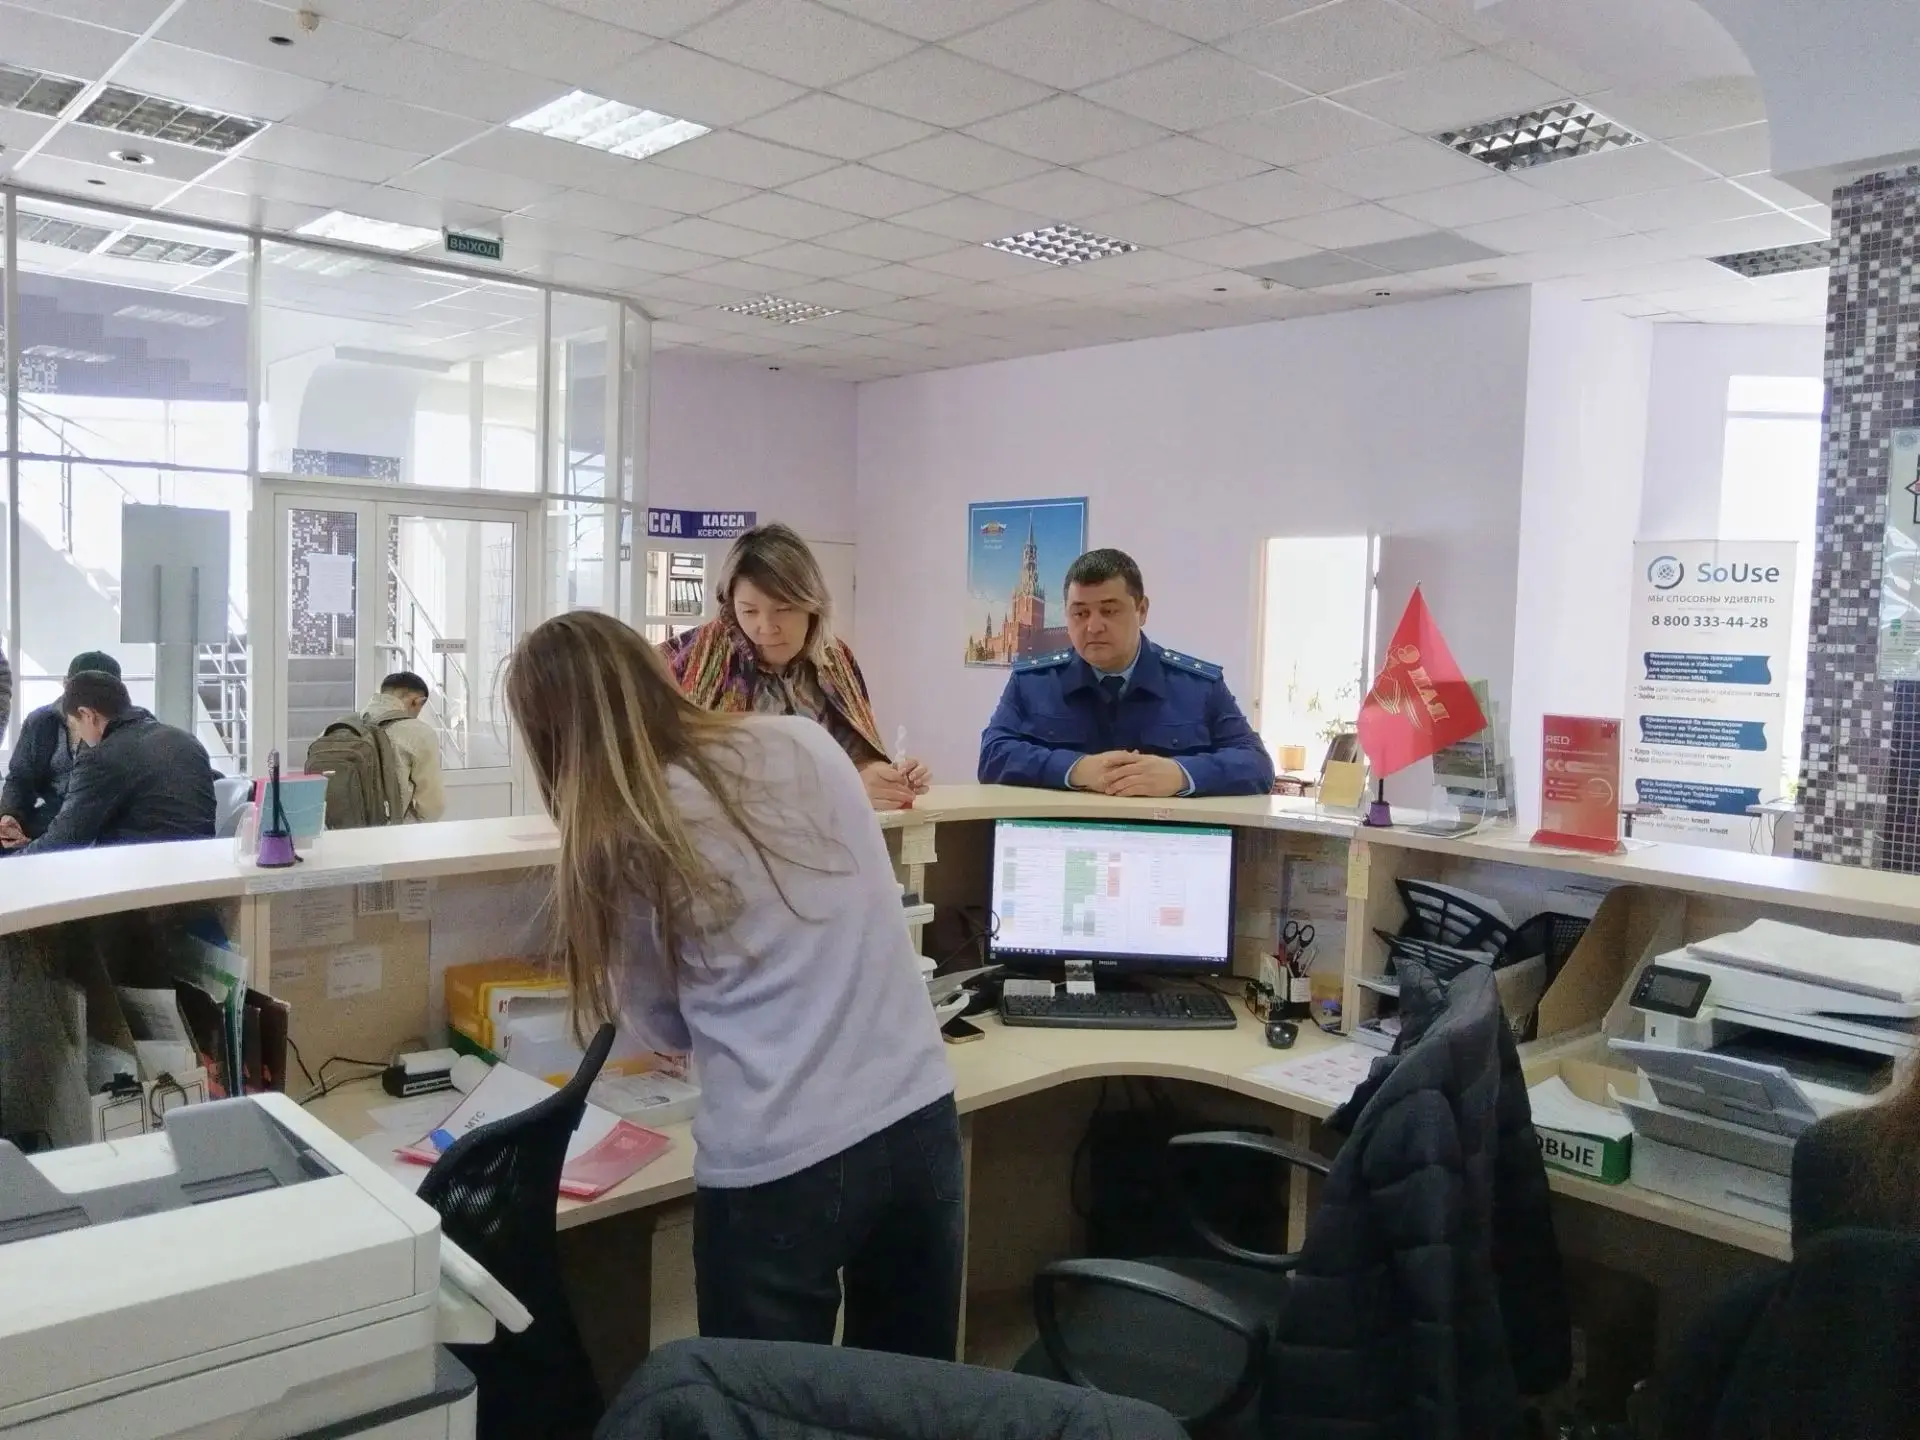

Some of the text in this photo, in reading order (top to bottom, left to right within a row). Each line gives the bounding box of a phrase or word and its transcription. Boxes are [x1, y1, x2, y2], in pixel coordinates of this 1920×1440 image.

[450, 237, 497, 256] ВЫХОД
[648, 511, 682, 534] ССА
[702, 514, 745, 527] КАССА
[698, 529, 744, 537] КСЕРОКОПИ
[1697, 562, 1780, 582] SoUse
[1666, 595, 1721, 603] СПОСОБНЫ
[1724, 596, 1776, 604] УДИВЛЯТЬ
[1651, 615, 1768, 628] 8 800 333-44-28
[1545, 735, 1570, 745] RED
[464, 1111, 485, 1129] МТС
